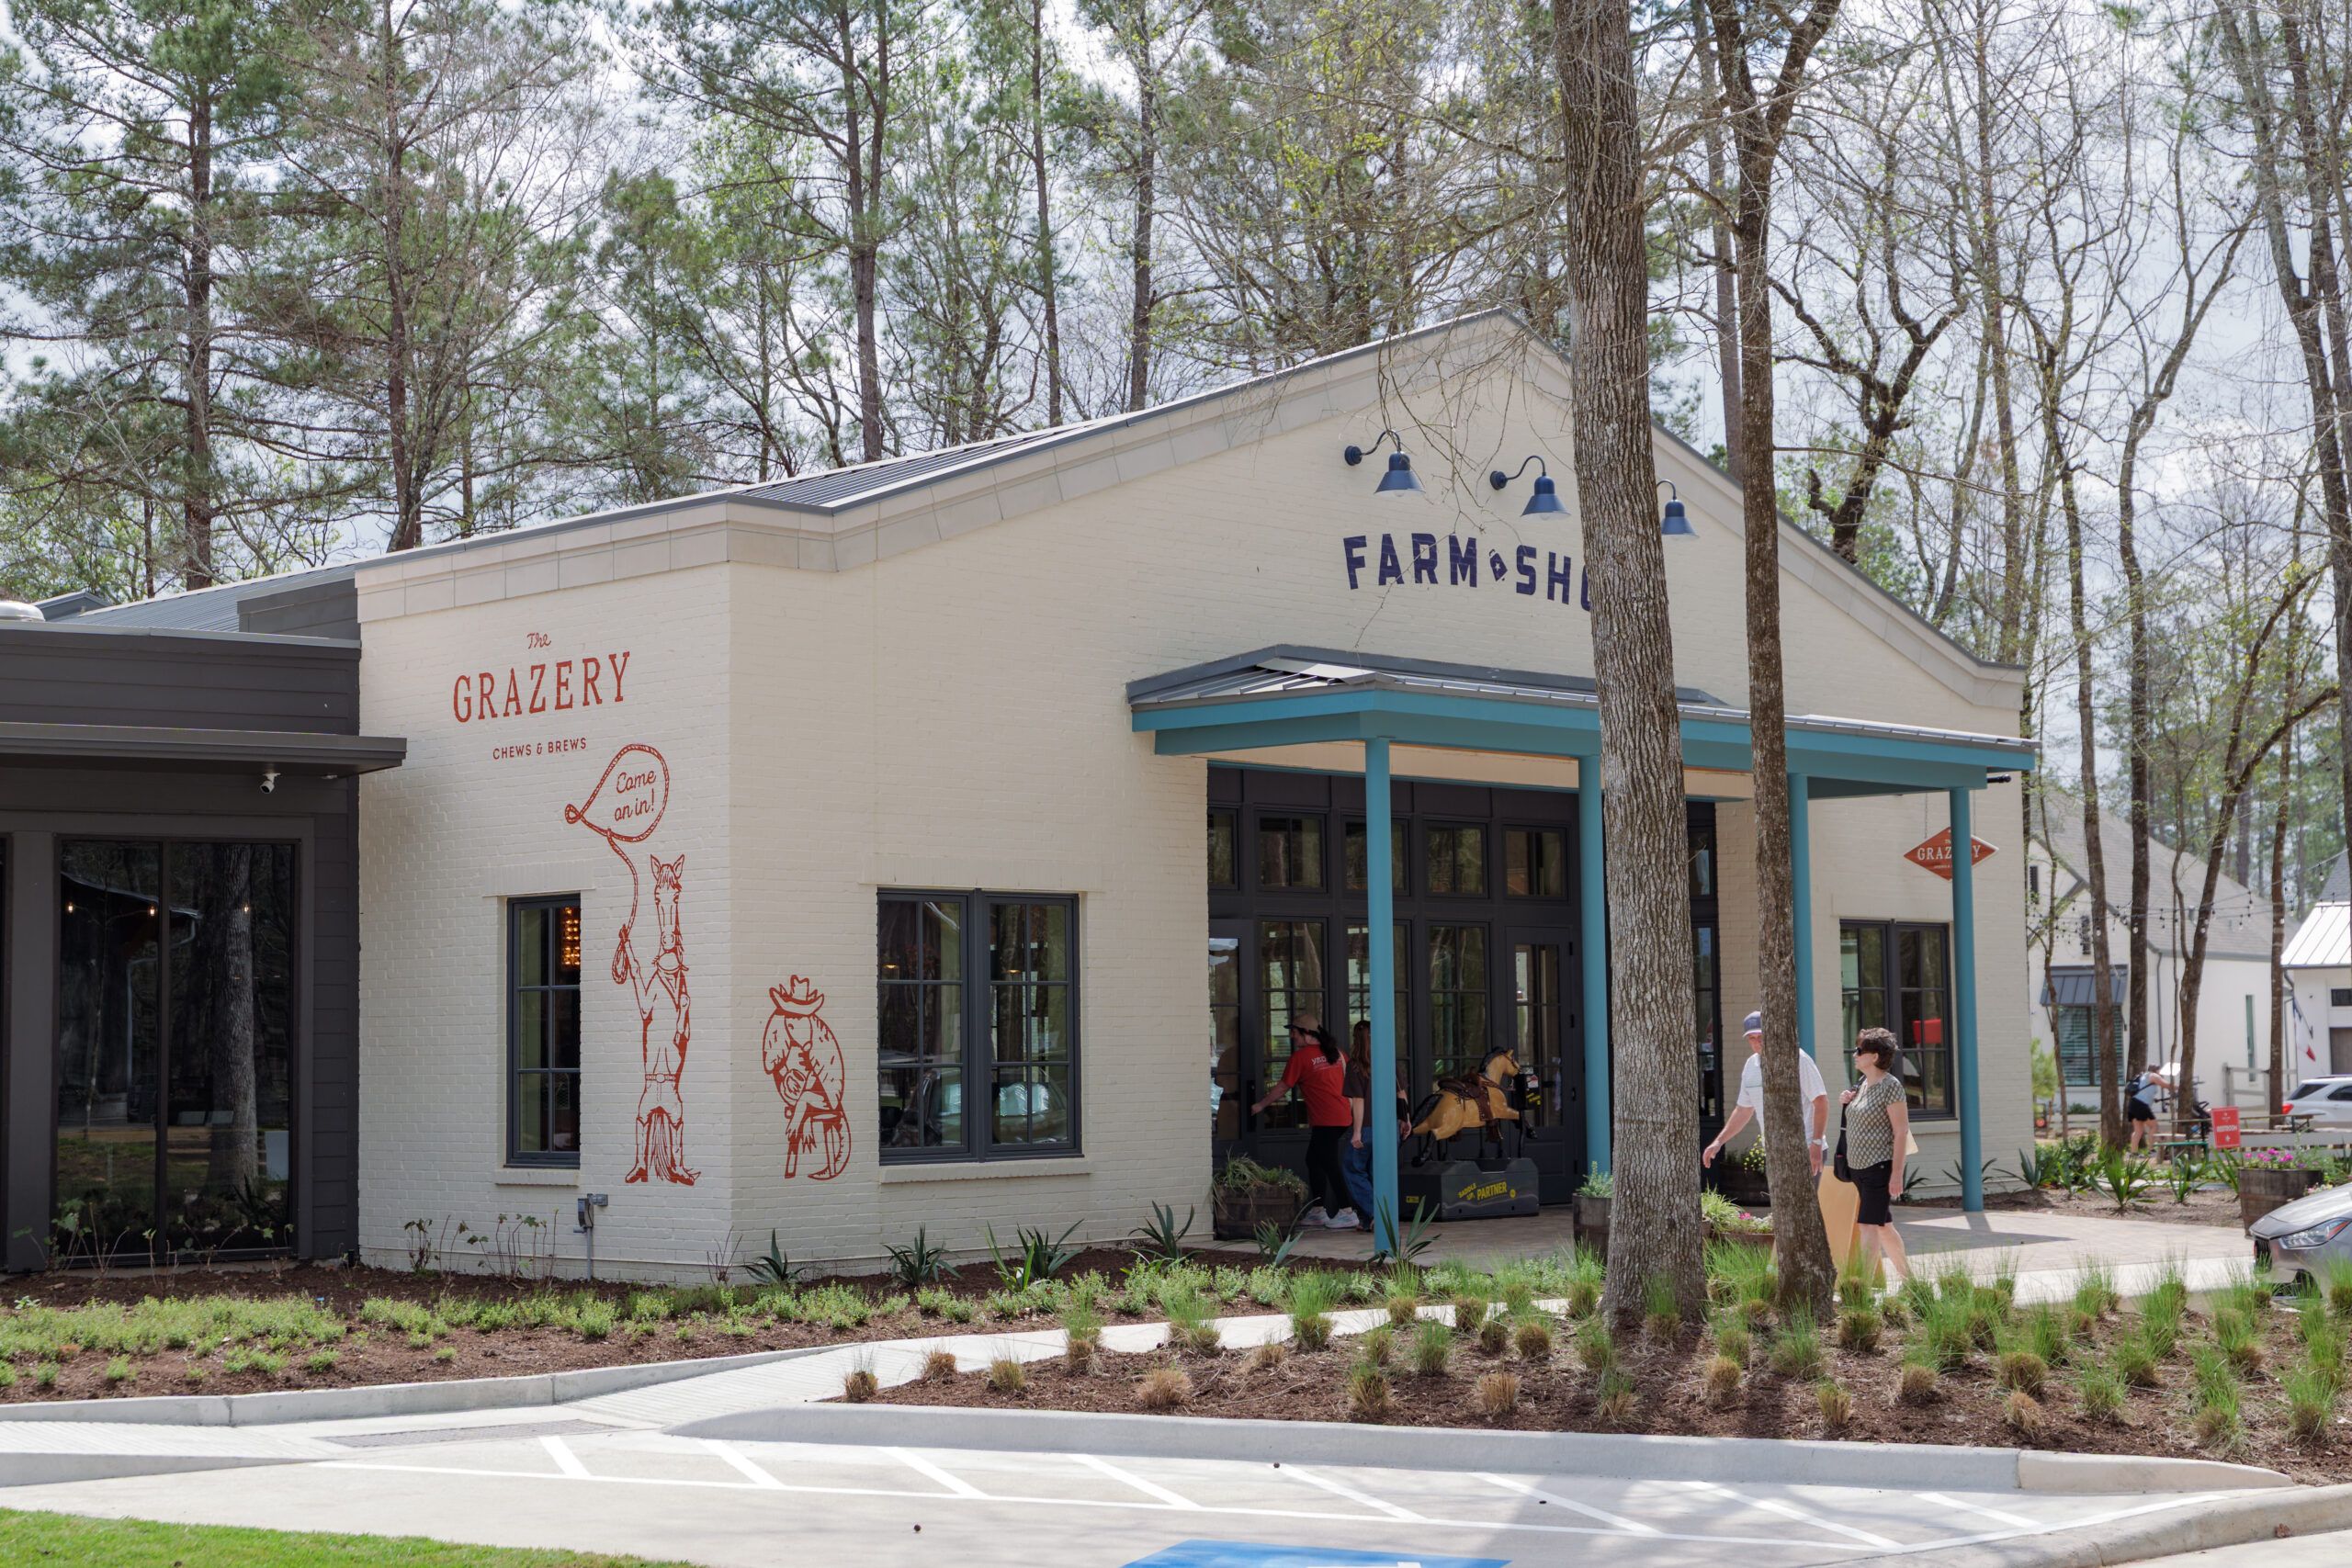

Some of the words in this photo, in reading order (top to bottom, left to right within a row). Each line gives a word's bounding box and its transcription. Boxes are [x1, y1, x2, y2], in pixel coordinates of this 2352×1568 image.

[1342, 532, 1477, 590] FARM
[526, 632, 551, 649] The
[453, 650, 630, 723] GRAZERY
[492, 744, 532, 761] CHEWS
[536, 742, 543, 755] &
[548, 737, 587, 754] BREWS
[616, 770, 657, 794] Come
[614, 804, 634, 821] on
[634, 788, 655, 815] in!
[1917, 844, 1982, 861] GRAZY
[1476, 1180, 1508, 1201] PARTNER
